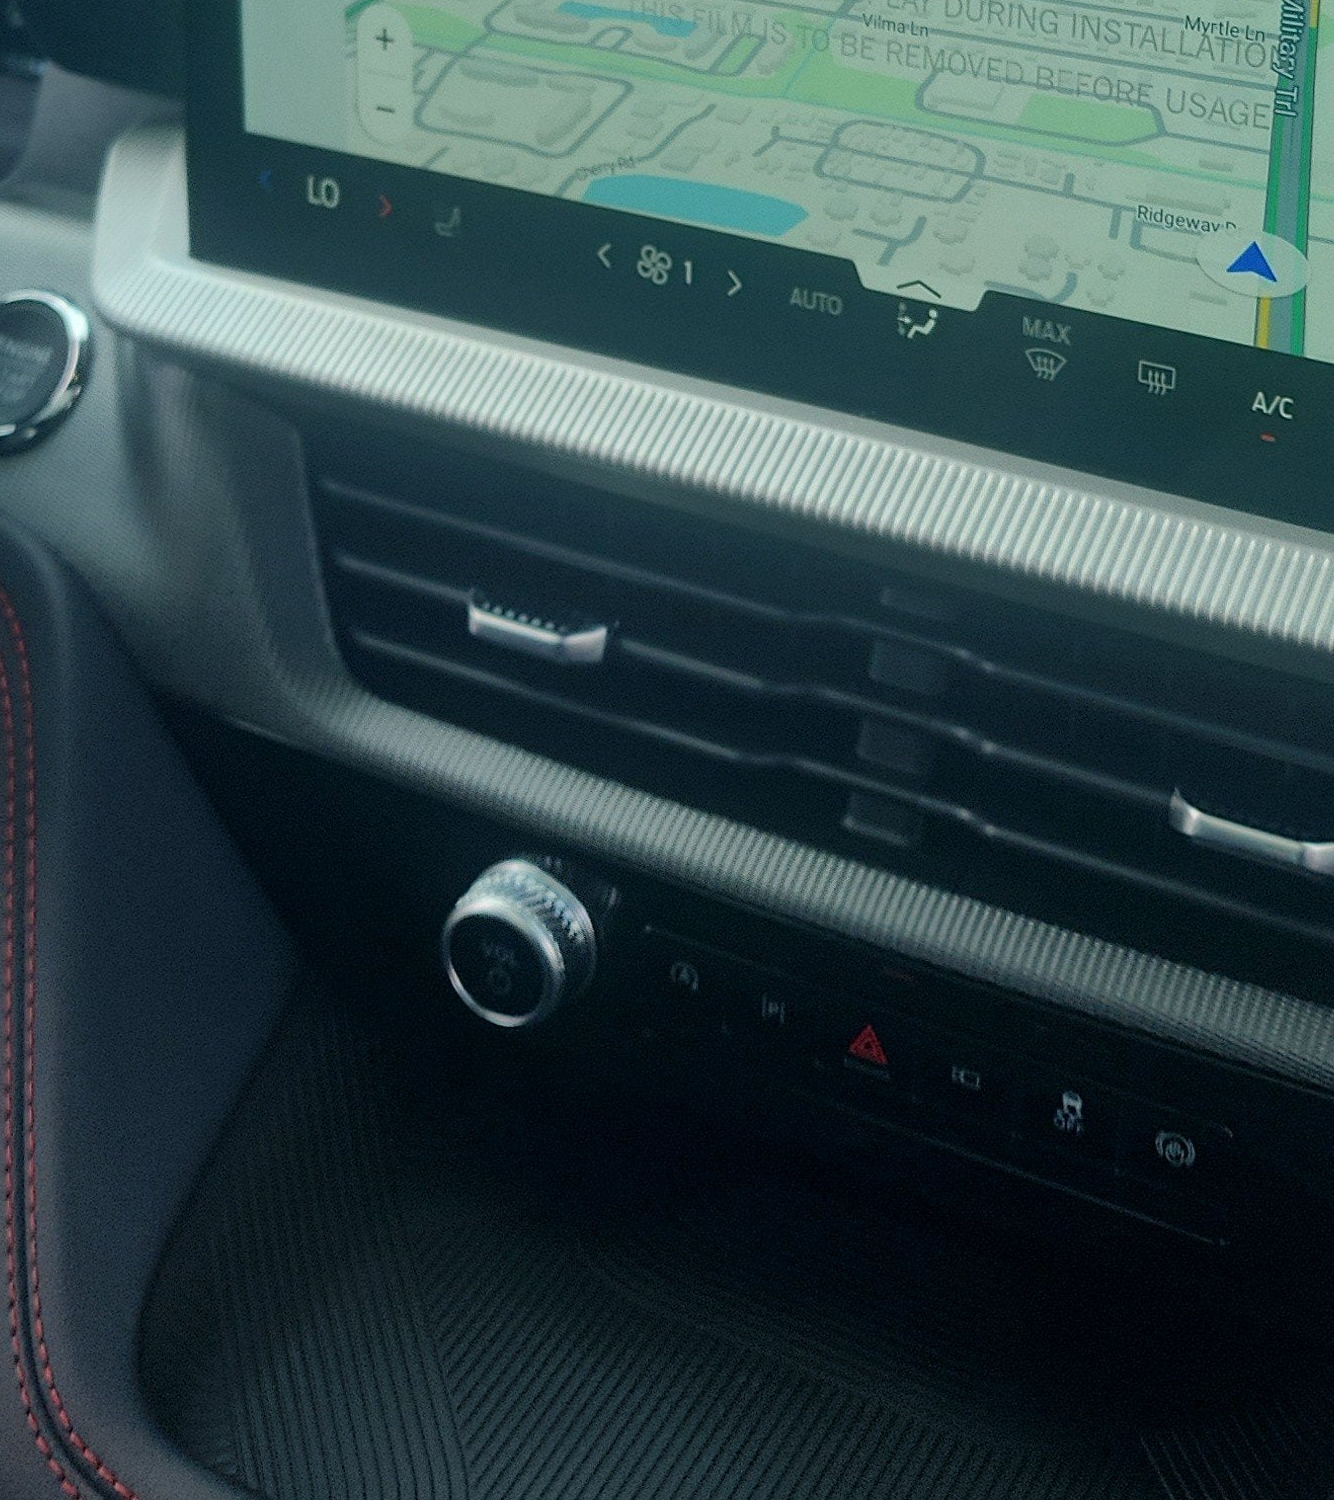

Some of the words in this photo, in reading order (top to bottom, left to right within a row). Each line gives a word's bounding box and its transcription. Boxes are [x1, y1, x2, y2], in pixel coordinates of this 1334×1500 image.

[861, 13, 906, 34] Vilma
[910, 23, 929, 38] Ln
[1184, 14, 1241, 39] Myrtle
[1244, 26, 1267, 43] Ln
[692, 7, 754, 38] FILM
[762, 18, 787, 46] IS
[795, 23, 830, 53] TO
[840, 31, 877, 62] BE
[885, 39, 1023, 86] REMOVED
[1035, 65, 1154, 106] BEFORE
[1166, 86, 1271, 131] USAGE
[1274, 86, 1300, 118] Trl
[617, 156, 635, 169] Rd
[306, 175, 340, 209] LO
[684, 261, 694, 285] 1
[789, 287, 844, 317] AUTO
[1022, 317, 1071, 346] MAX
[1252, 390, 1294, 421] A/C
